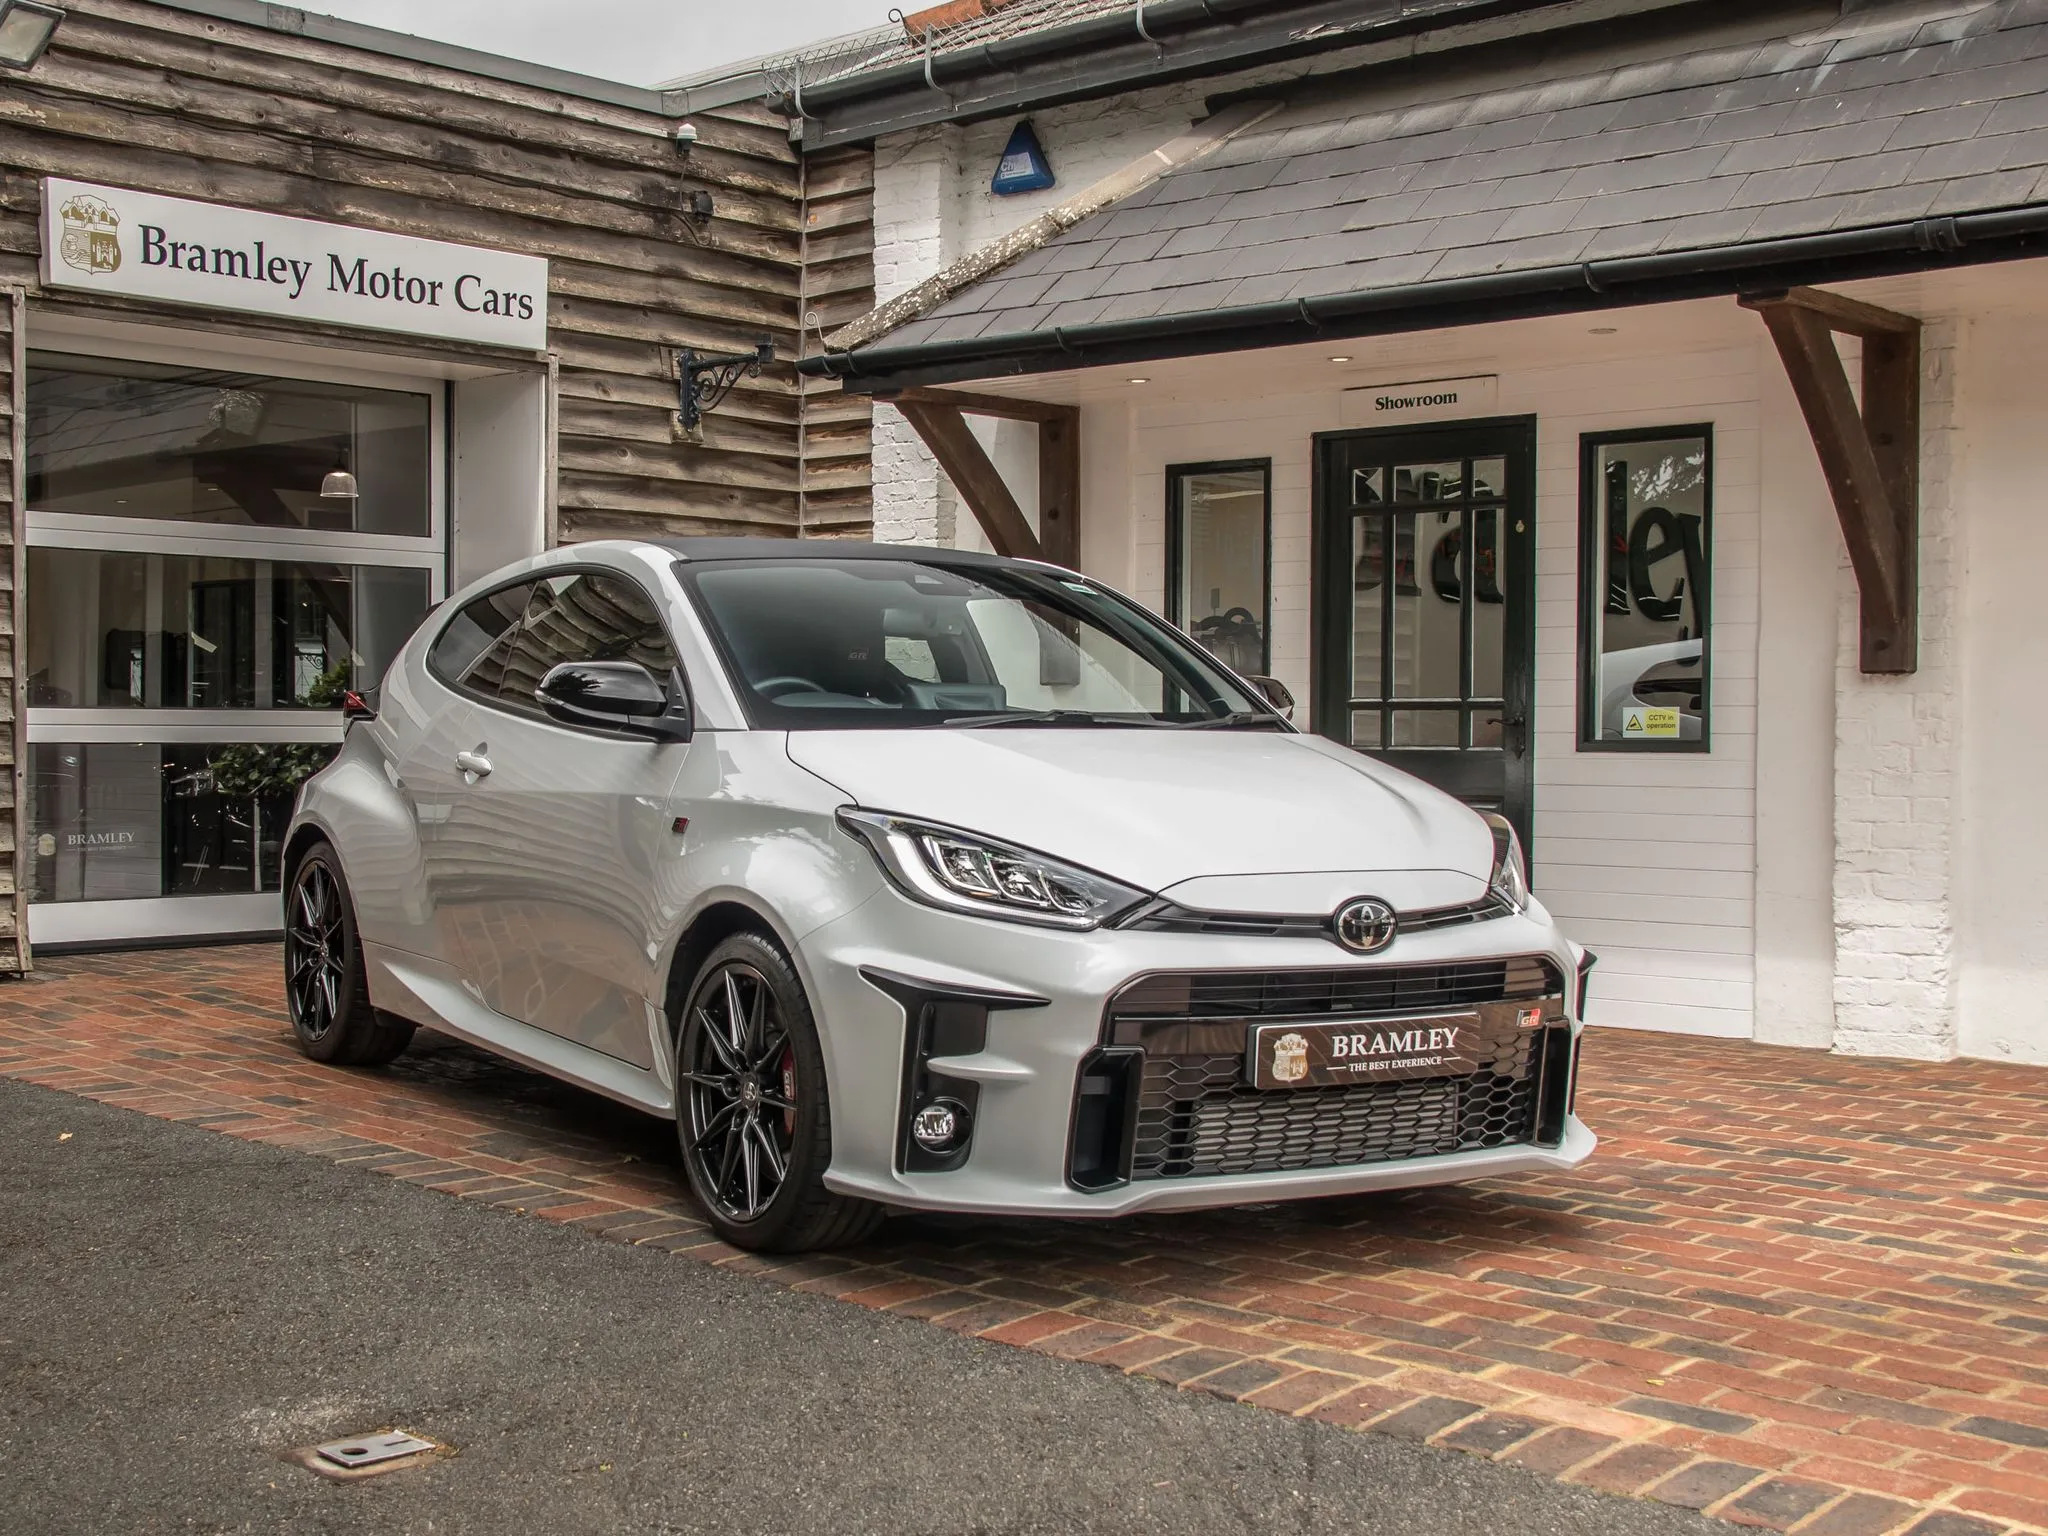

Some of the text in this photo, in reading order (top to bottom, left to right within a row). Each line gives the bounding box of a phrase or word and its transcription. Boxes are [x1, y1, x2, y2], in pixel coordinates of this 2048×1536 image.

[138, 224, 534, 320] Bramley Motor Cars
[1375, 392, 1458, 411] Showroom
[67, 832, 135, 845] BRAMLEY
[1332, 1027, 1459, 1057] BRAMLEY
[1349, 1056, 1442, 1072] THE BEST EXPERIENCE
